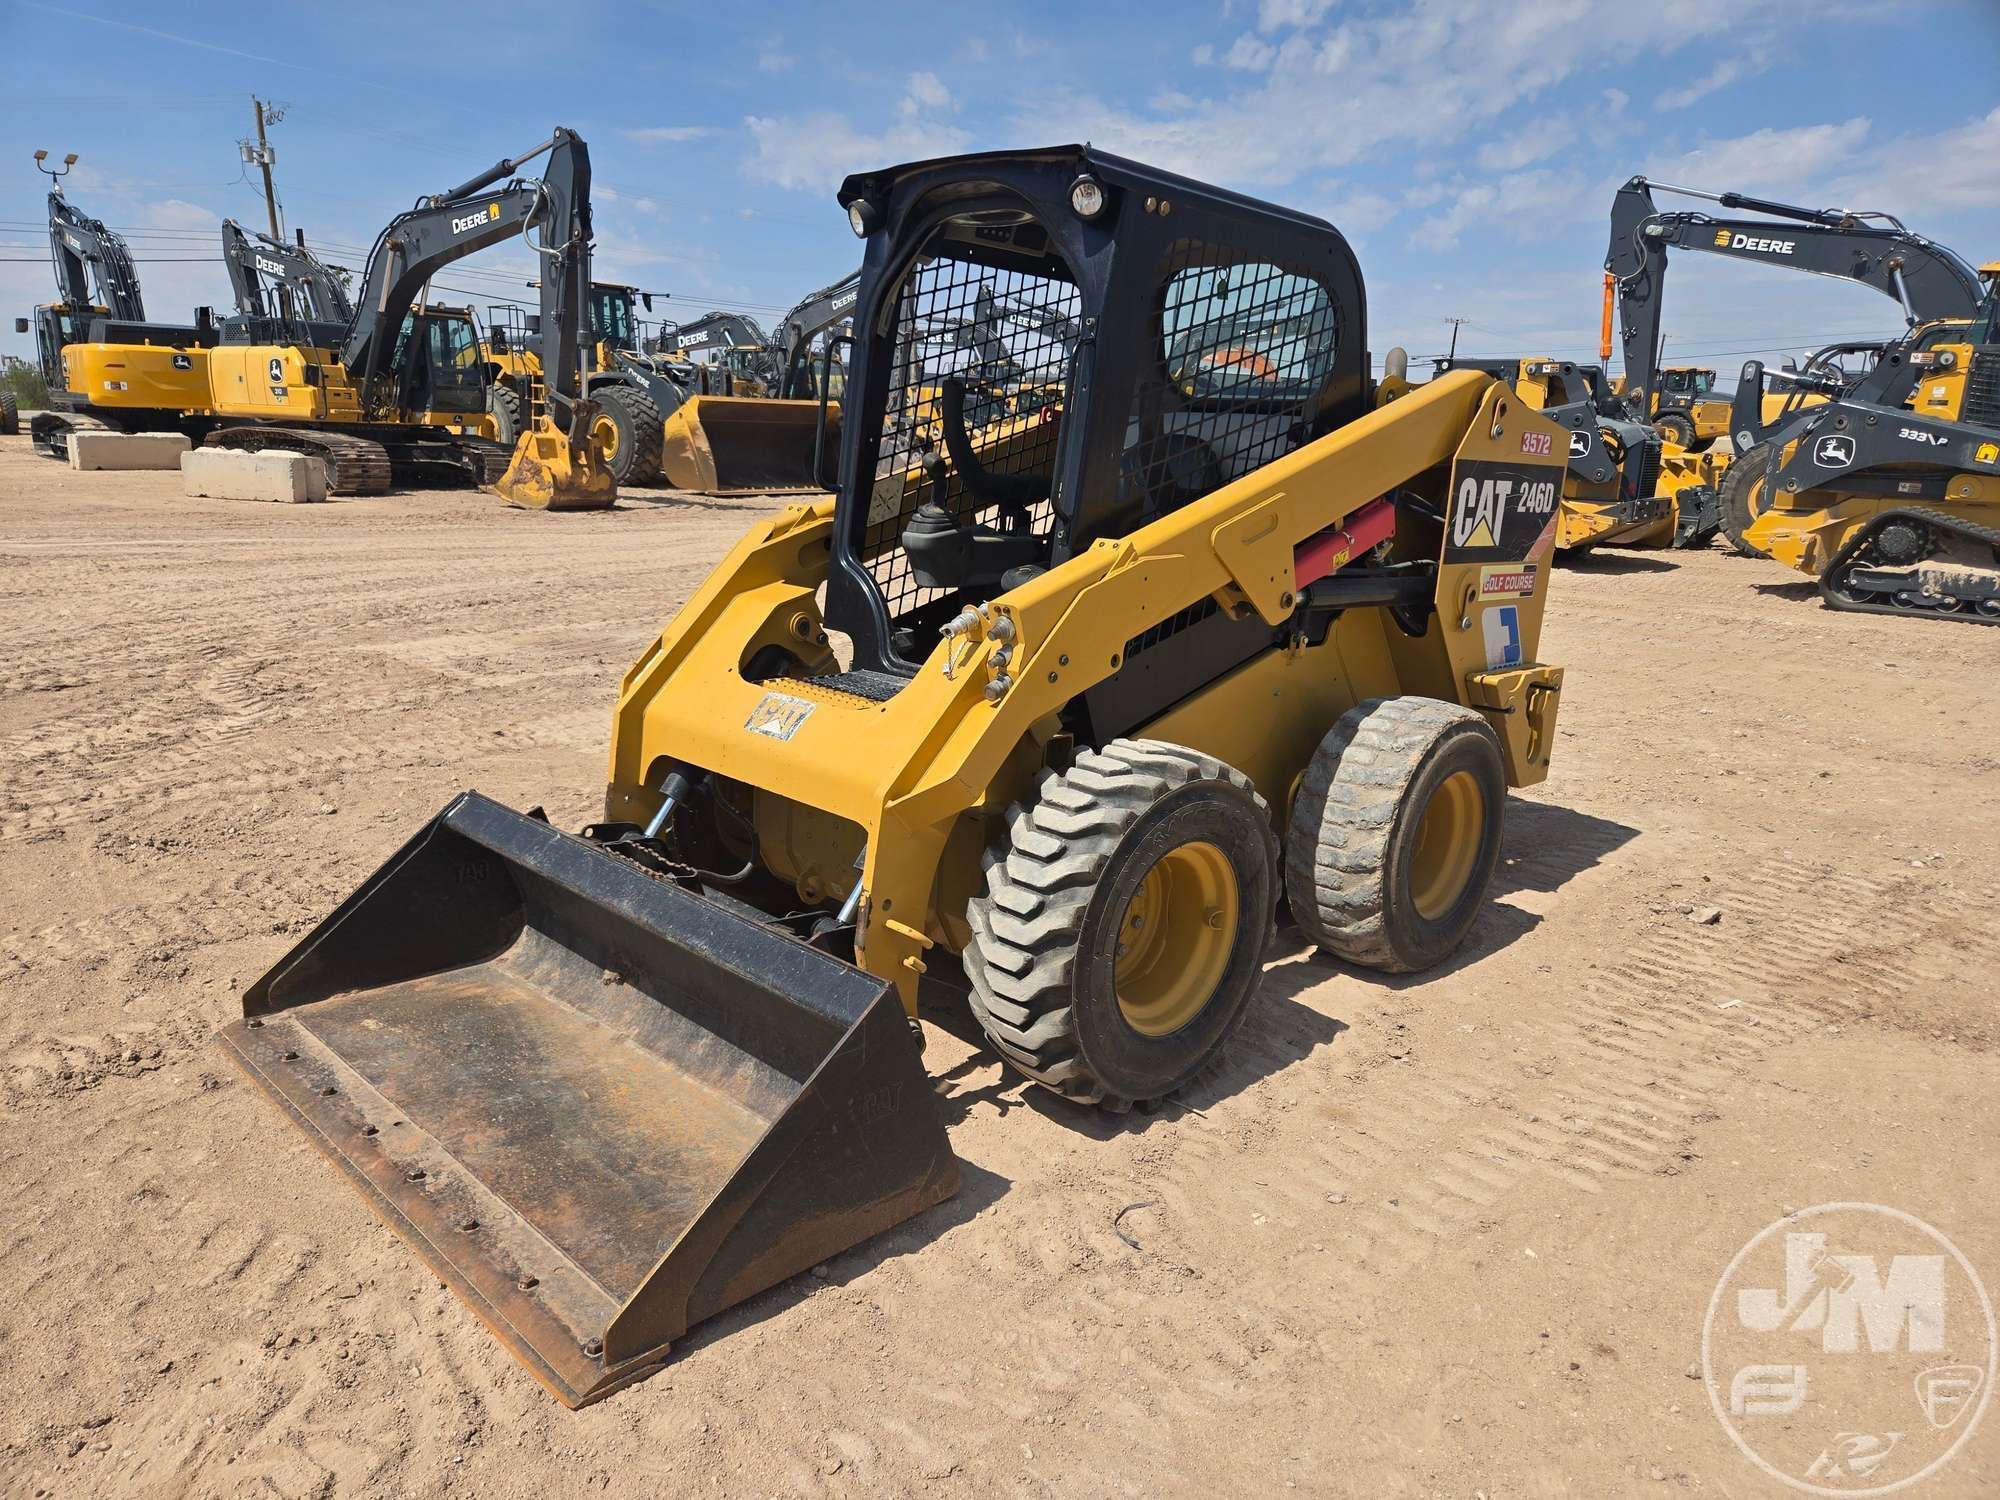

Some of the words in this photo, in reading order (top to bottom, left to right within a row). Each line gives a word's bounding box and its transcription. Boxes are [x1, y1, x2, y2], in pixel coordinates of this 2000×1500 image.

[452, 210, 489, 235] DEERE
[1732, 233, 1796, 254] DEERE
[255, 254, 286, 277] DEERE
[831, 291, 858, 310] DEERE
[677, 330, 709, 348] DEERE
[1522, 432, 1552, 454] 3572
[1454, 477, 1513, 548] CAT
[1517, 481, 1555, 514] 246D
[1504, 575, 1534, 590] COURSE
